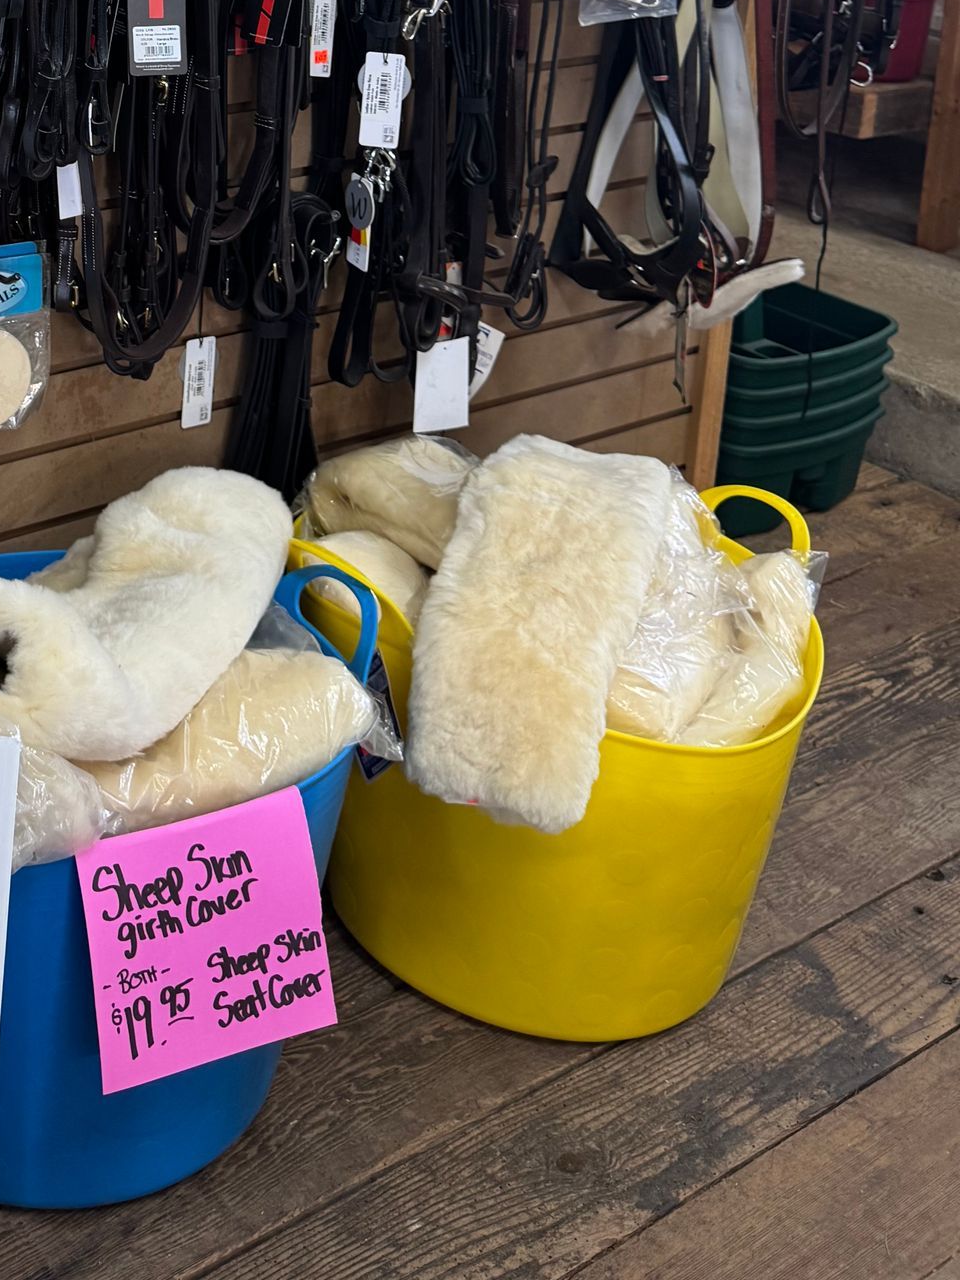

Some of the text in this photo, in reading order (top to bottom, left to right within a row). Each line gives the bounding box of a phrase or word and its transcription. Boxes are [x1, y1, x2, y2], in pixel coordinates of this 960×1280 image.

[350, 191, 367, 219] W
[92, 843, 252, 922] Sheep Skin
[117, 878, 259, 960] girth Cover
[206, 928, 321, 984] Sheep Skin
[212, 969, 326, 1028] Seat Cover
